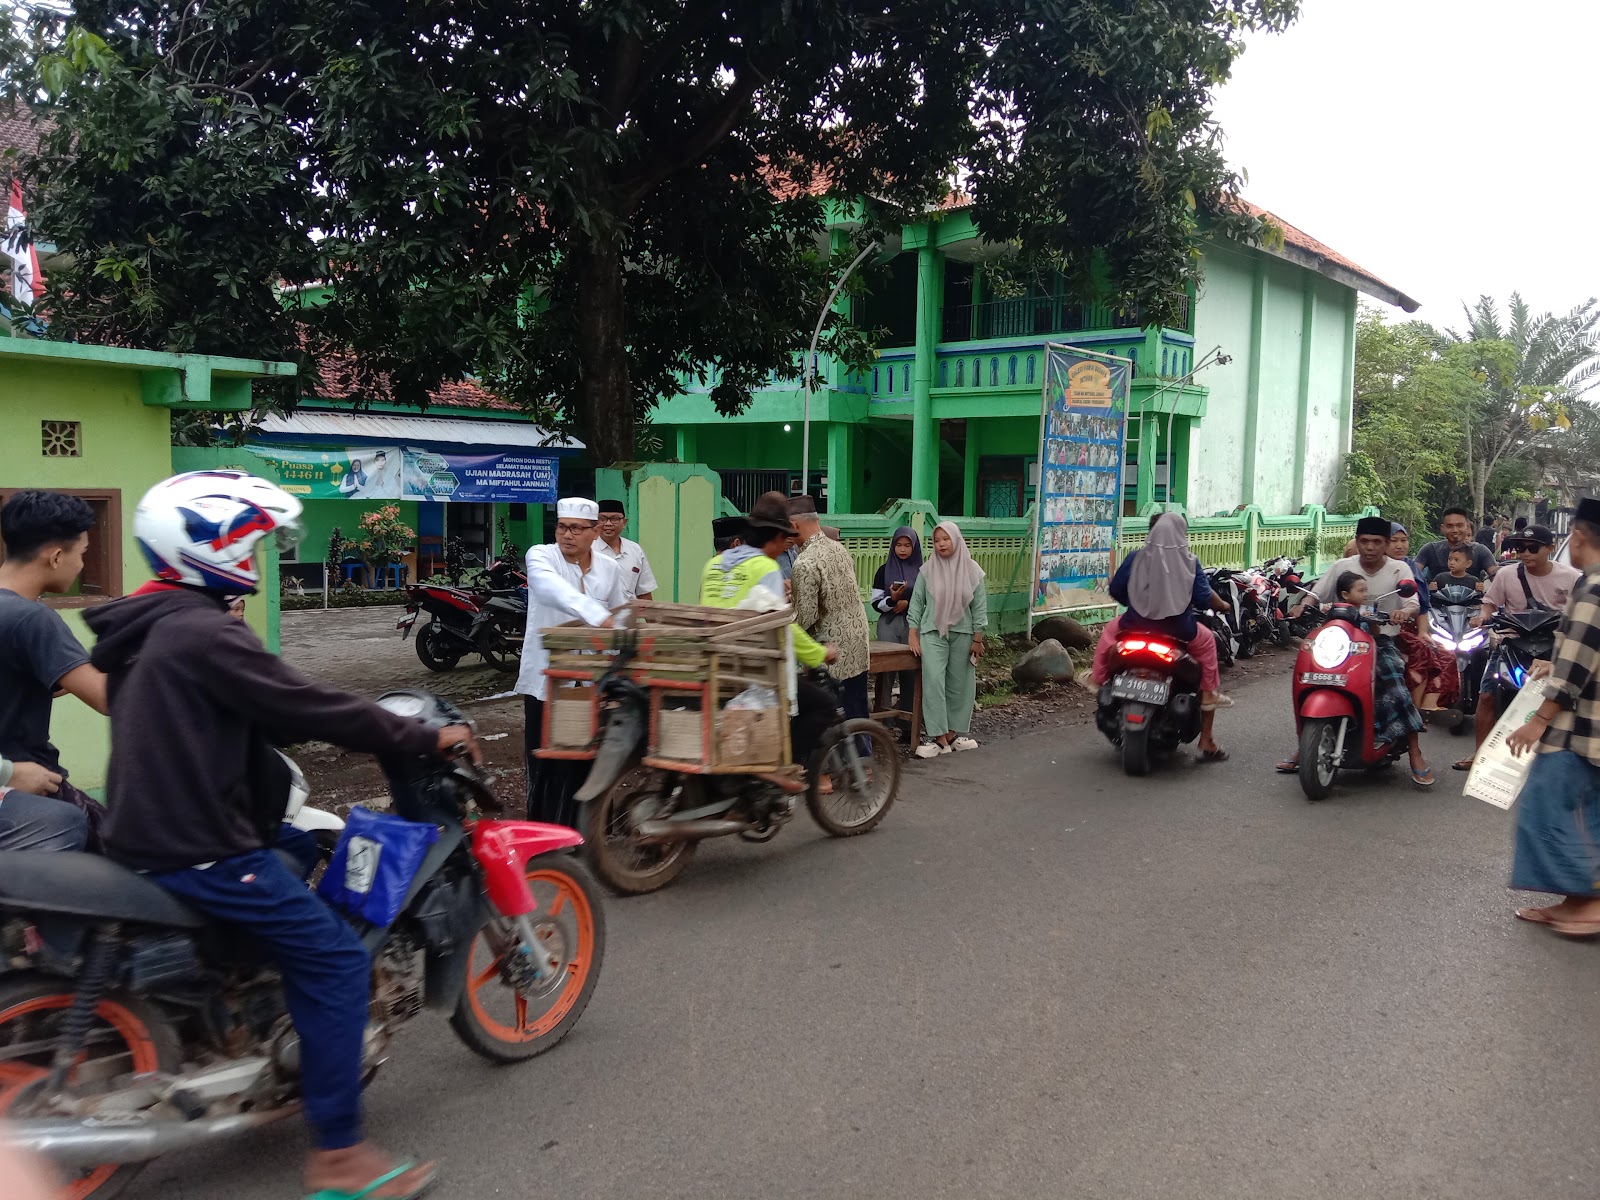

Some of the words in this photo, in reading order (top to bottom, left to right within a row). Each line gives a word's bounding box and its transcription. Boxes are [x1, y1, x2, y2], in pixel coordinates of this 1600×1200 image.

[281, 460, 314, 470] Puasa
[283, 470, 312, 479] 1446
[314, 471, 324, 480] H
[465, 469, 488, 477] UJIAN
[488, 470, 531, 479] MADRASAH
[532, 471, 551, 480] (UM)
[488, 479, 521, 487] MIFTAHUL
[521, 480, 550, 488] JANNAH
